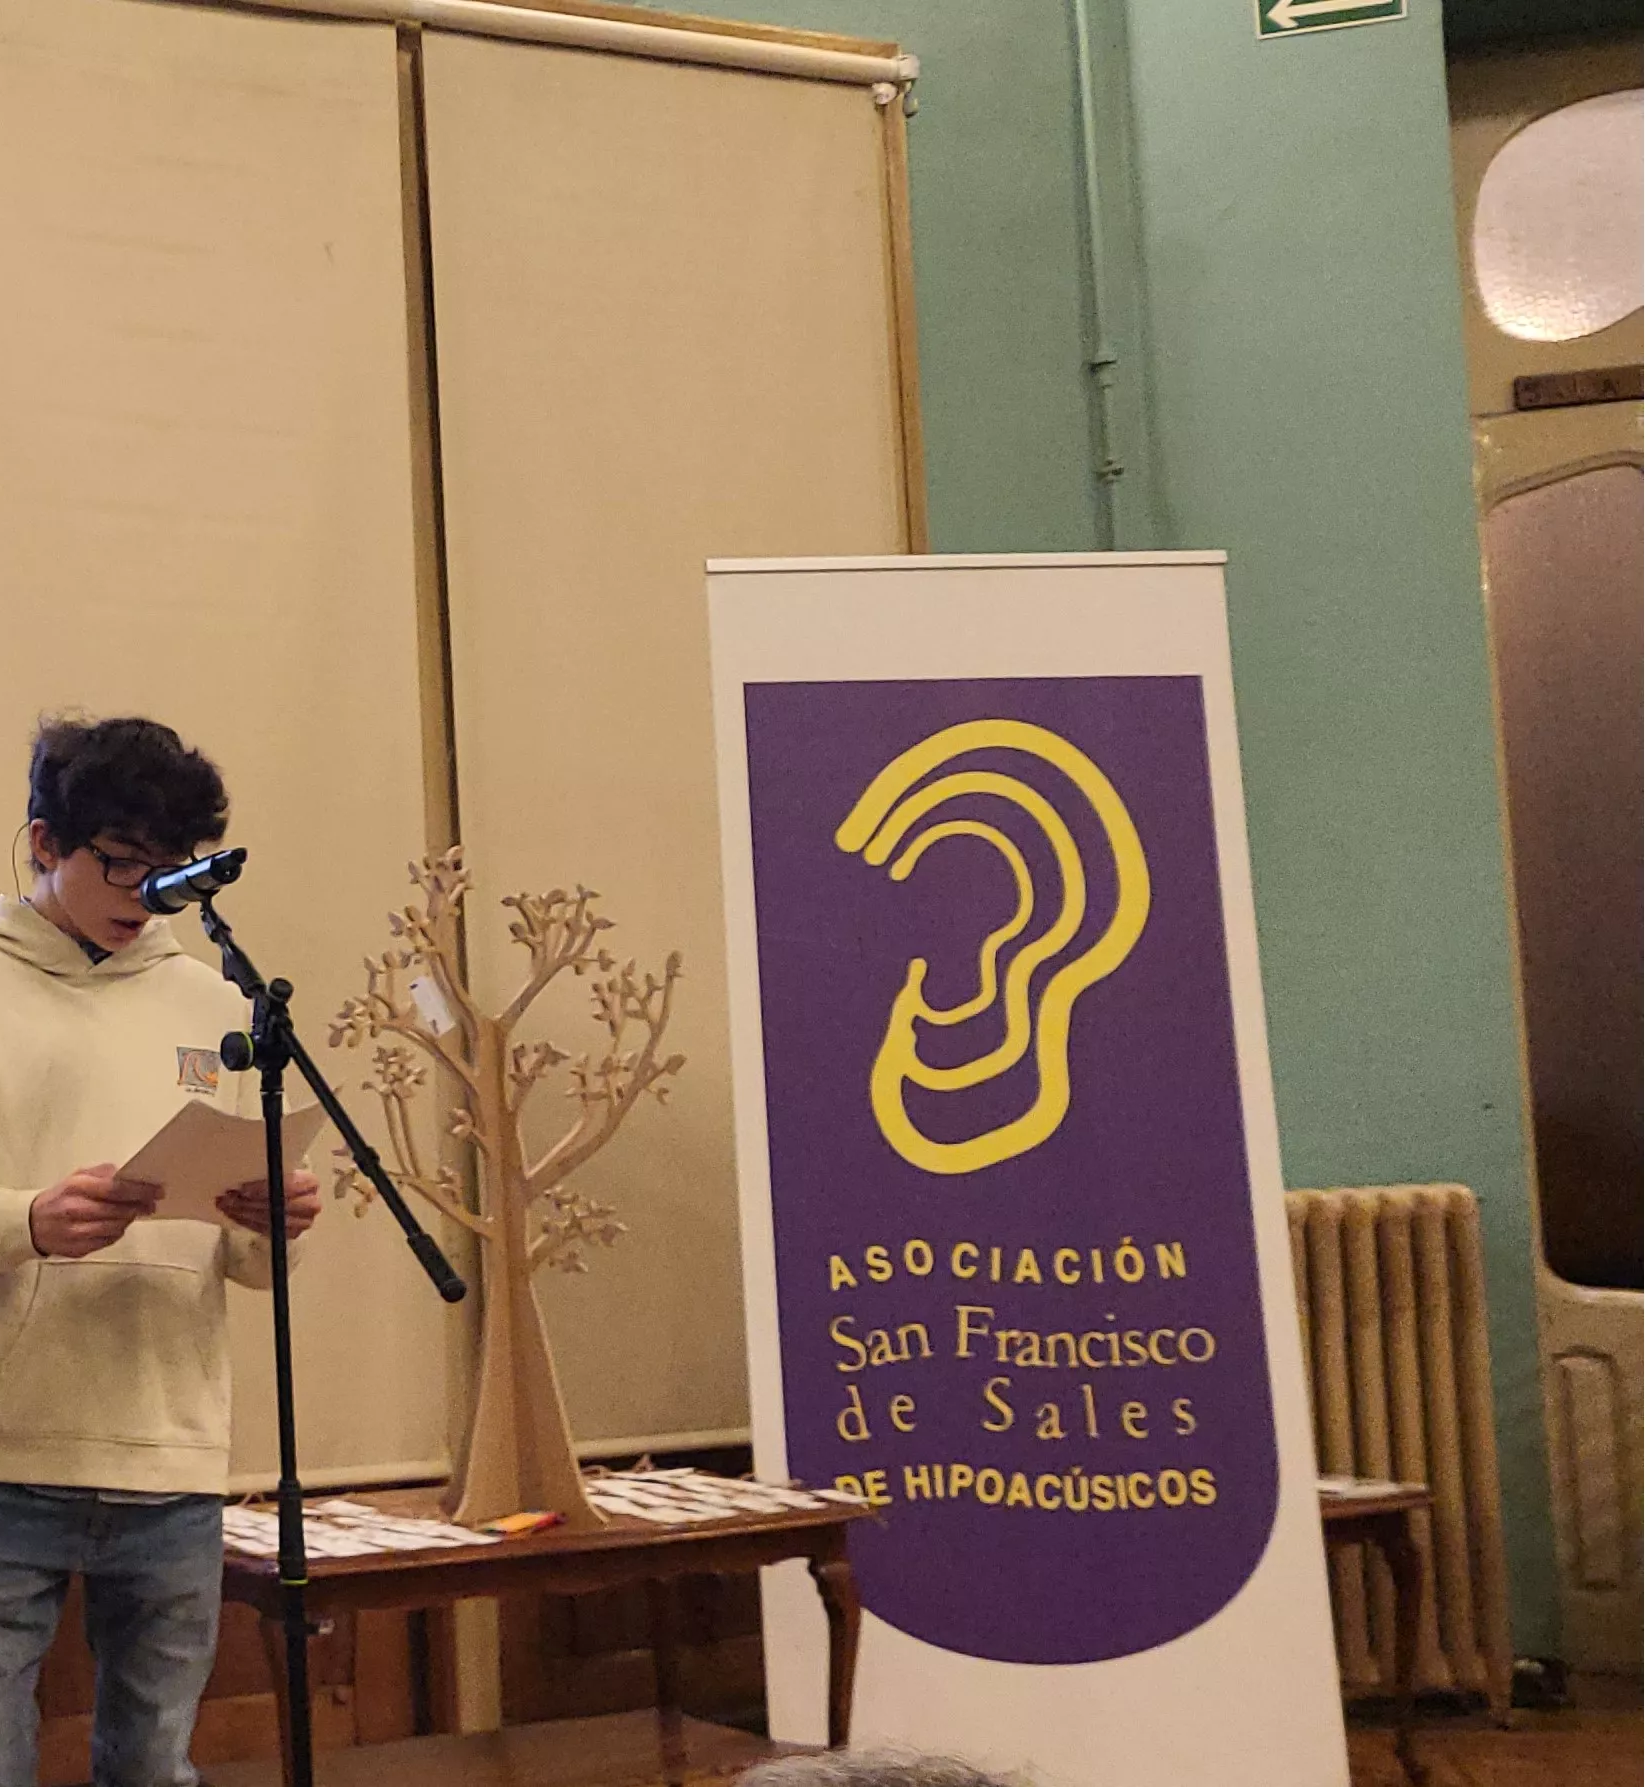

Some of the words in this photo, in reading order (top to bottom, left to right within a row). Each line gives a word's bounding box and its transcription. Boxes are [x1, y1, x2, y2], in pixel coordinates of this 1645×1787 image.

[828, 1236, 1188, 1292] ASOCIACIÓN
[829, 1315, 934, 1373] San
[955, 1304, 1217, 1369] Francisco
[836, 1384, 917, 1442] de
[981, 1377, 1198, 1440] Sales
[833, 1468, 893, 1508] DE
[903, 1462, 1218, 1513] HIPOACÚSICOS
